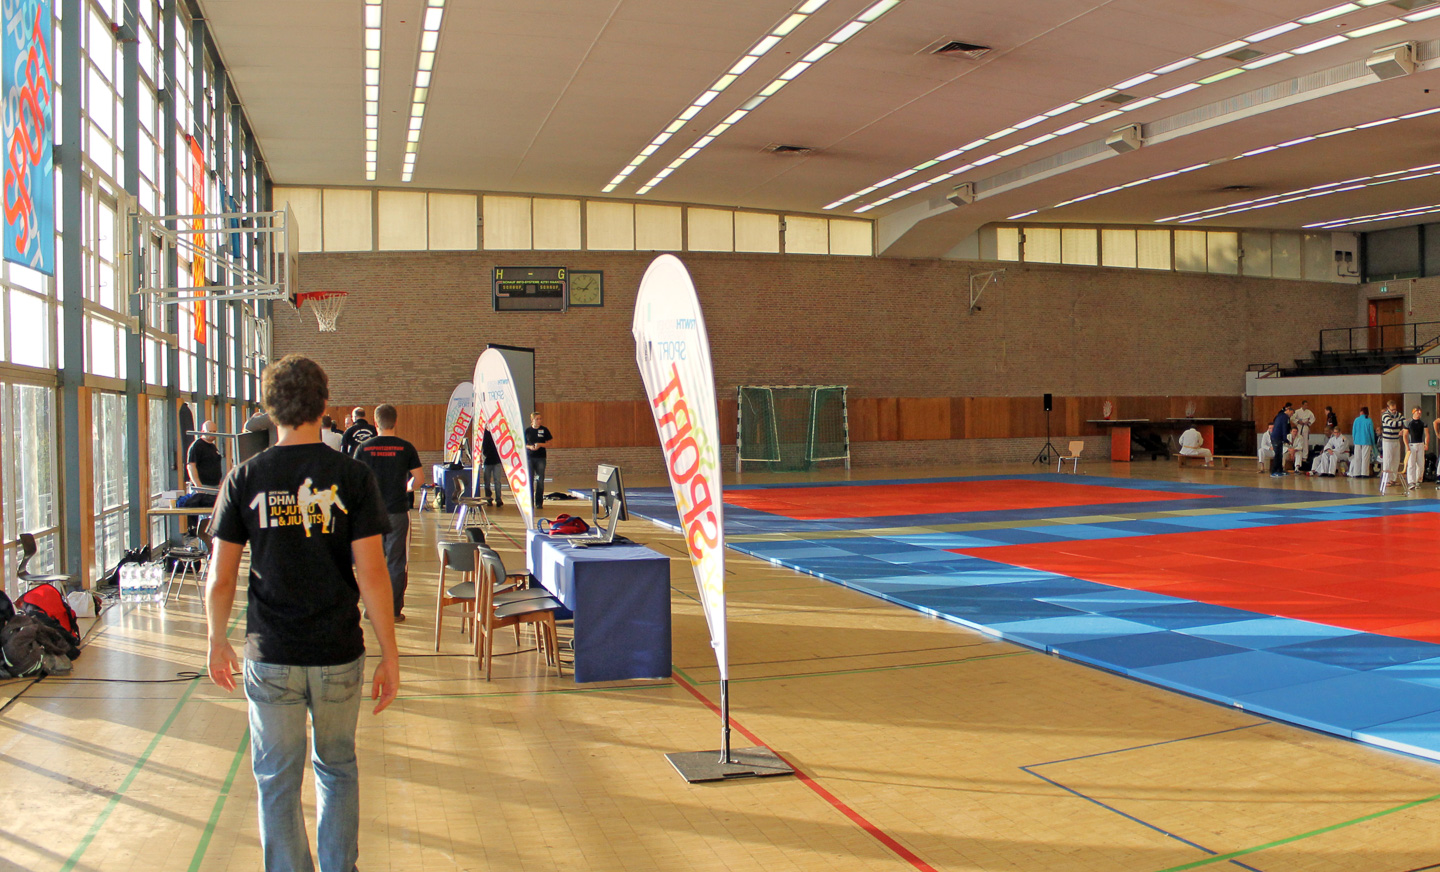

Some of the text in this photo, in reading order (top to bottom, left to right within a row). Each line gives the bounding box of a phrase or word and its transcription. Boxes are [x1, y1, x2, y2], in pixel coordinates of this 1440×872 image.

[4, 3, 53, 254] SPORT
[496, 269, 504, 280] H
[558, 269, 565, 279] G
[446, 407, 472, 453] SPORT
[268, 494, 296, 506] DHM
[278, 515, 286, 526] &
